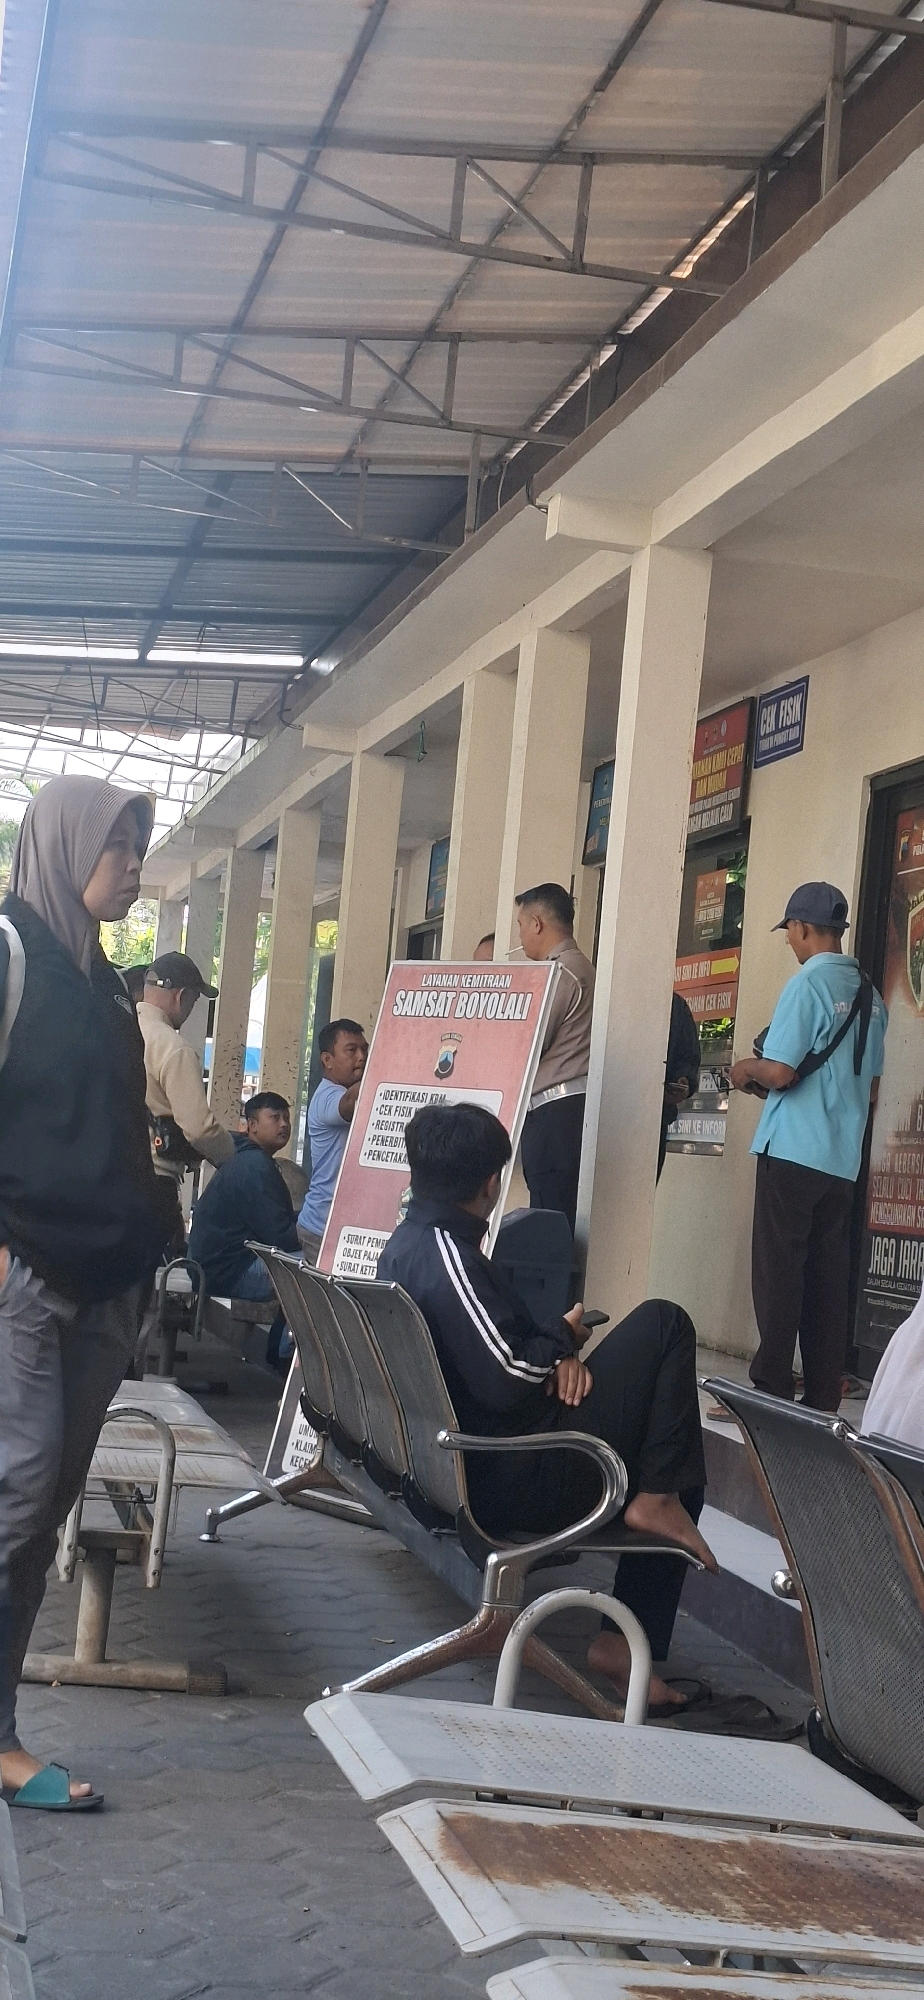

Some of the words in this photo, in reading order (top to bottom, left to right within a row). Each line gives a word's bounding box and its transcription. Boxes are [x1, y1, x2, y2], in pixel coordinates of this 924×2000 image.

[760, 702, 777, 737] CEK
[778, 692, 803, 729] FISIK
[698, 959, 711, 978] INFO
[421, 973, 459, 988] LAYANAN
[460, 974, 513, 990] KEMITRAAN
[392, 989, 457, 1018] SAMSAT
[453, 992, 534, 1021] BOYOLALI
[382, 1089, 428, 1104] IDENTIFIKASI
[378, 1104, 392, 1116] CEK
[393, 1105, 413, 1118] FISIK
[677, 1119, 693, 1134] SINI
[692, 1120, 702, 1135] KE
[345, 1233, 366, 1247] SURAT
[342, 1246, 361, 1260] OBJEK
[868, 1235, 897, 1277] JAGA
[339, 1260, 359, 1274] SURAT
